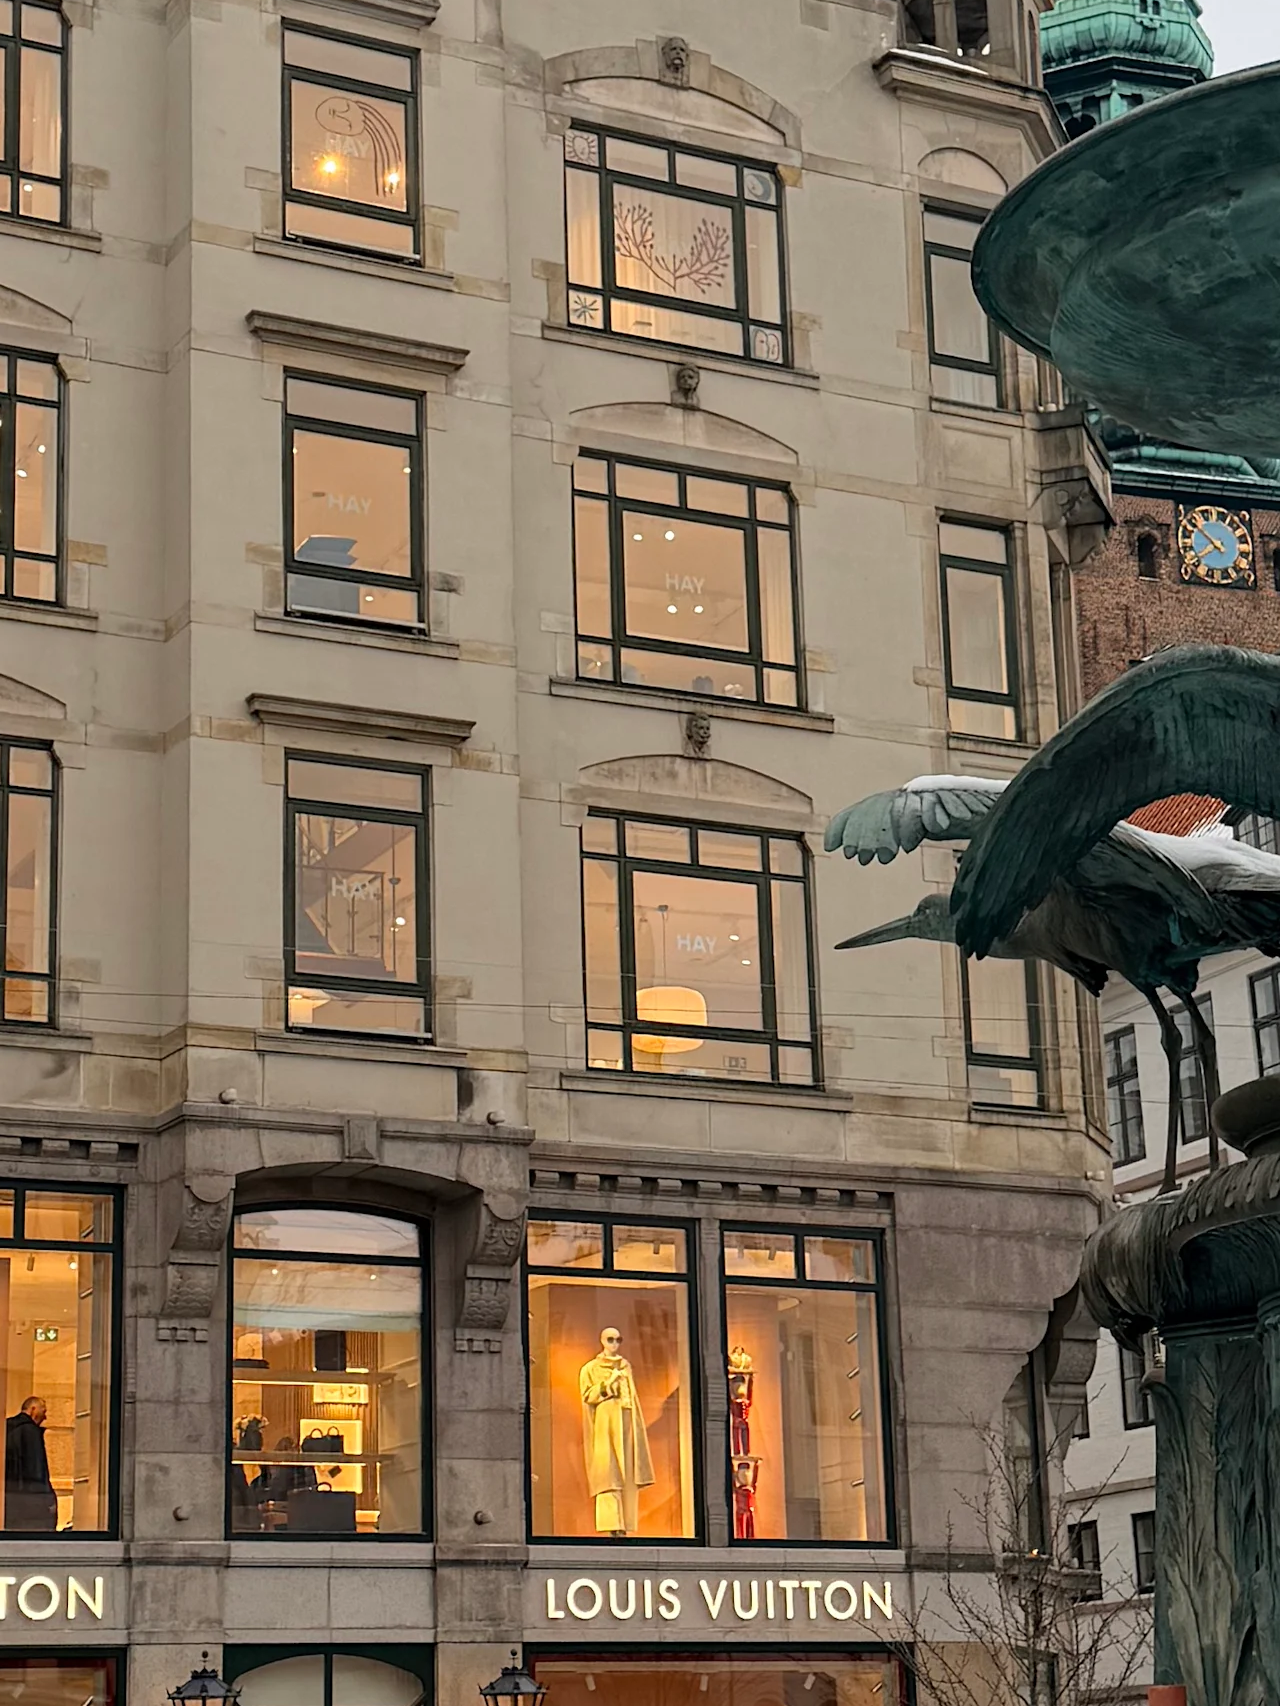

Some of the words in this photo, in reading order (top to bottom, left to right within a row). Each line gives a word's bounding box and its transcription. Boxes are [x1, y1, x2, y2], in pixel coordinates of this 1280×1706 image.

[327, 493, 372, 515] HAY
[666, 573, 705, 594] HAY
[677, 933, 717, 954] HAY
[546, 1578, 681, 1620] LOUIS
[700, 1579, 894, 1621] VUITTON
